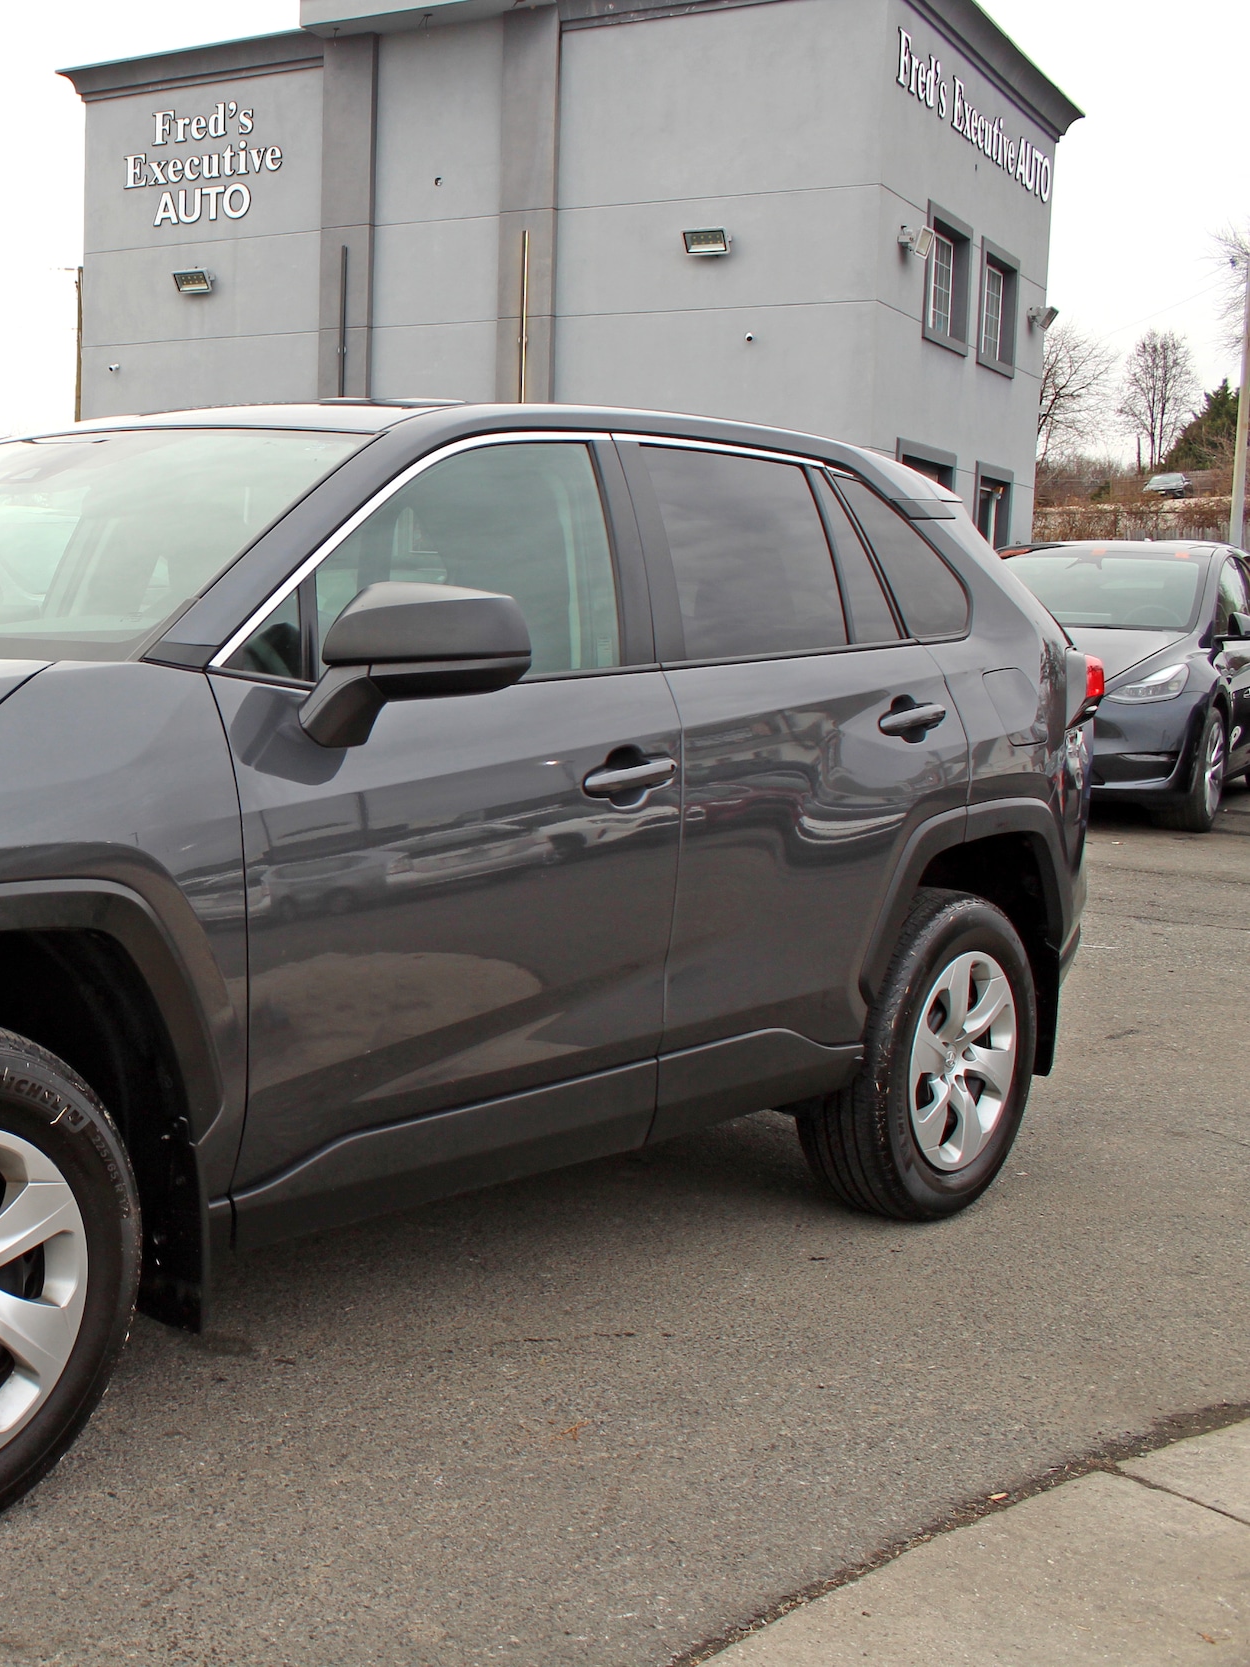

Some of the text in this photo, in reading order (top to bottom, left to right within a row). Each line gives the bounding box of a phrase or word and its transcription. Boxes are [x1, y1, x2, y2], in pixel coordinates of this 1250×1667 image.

[152, 101, 254, 146] Fred's
[896, 26, 1051, 203] Fred's Executive AUTO
[124, 140, 282, 189] Executive
[153, 182, 251, 227] AUTO
